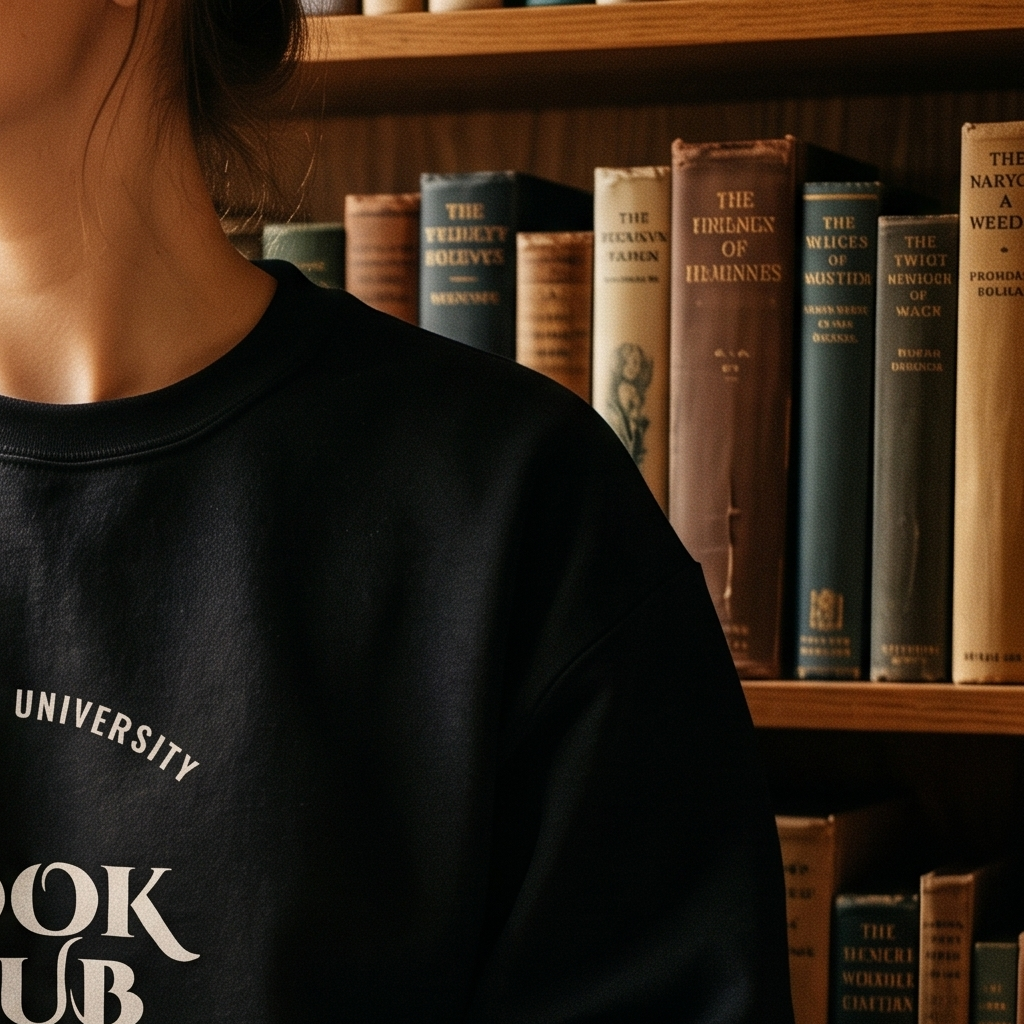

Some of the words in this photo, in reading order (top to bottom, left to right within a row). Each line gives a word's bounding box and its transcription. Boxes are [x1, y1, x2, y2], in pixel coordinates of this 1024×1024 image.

[990, 152, 1024, 166] THE
[717, 191, 754, 209] THE
[1000, 194, 1012, 208] A
[619, 212, 649, 224] THE
[823, 216, 855, 229] THE
[721, 240, 748, 257] OF
[905, 236, 936, 248] THE
[15, 688, 200, 782] UNIVERSITY
